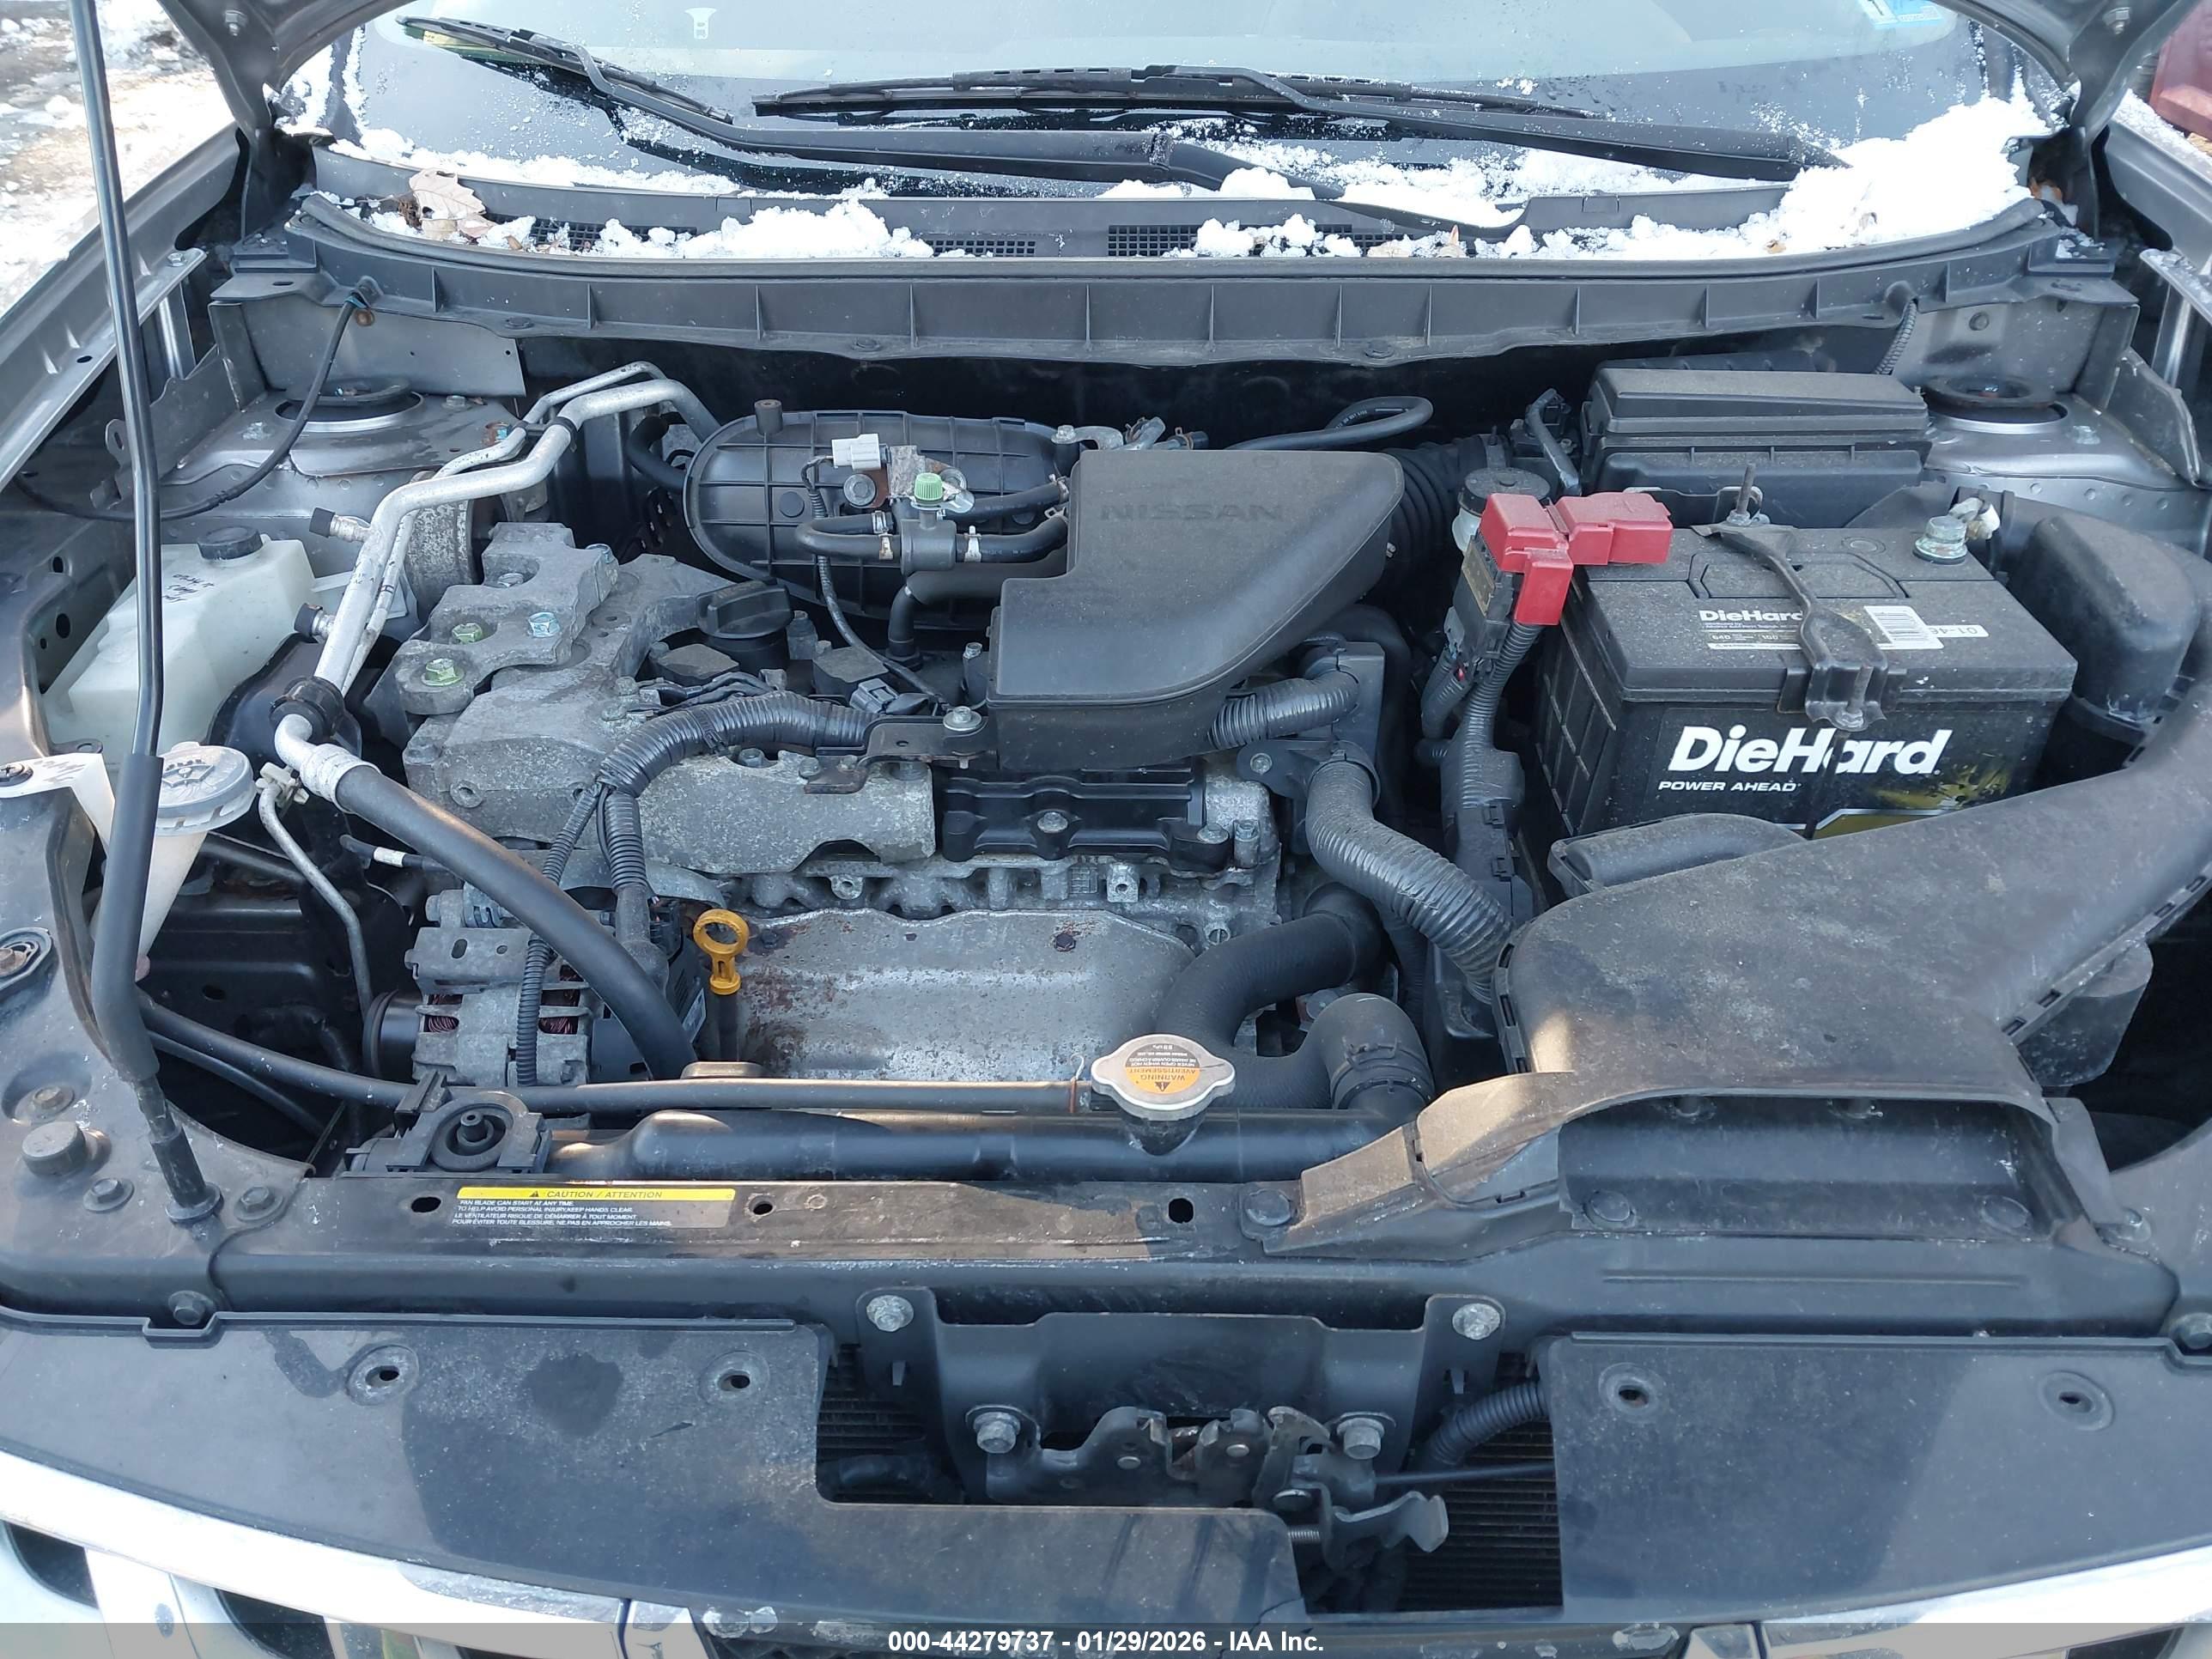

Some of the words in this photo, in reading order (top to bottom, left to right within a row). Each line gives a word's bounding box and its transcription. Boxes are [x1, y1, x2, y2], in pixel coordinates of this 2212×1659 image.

[1099, 503, 1284, 520] NISSAN
[1668, 724, 1954, 775] DieHard
[1658, 780, 1730, 792] POWER
[1730, 781, 1802, 793] AHEAD
